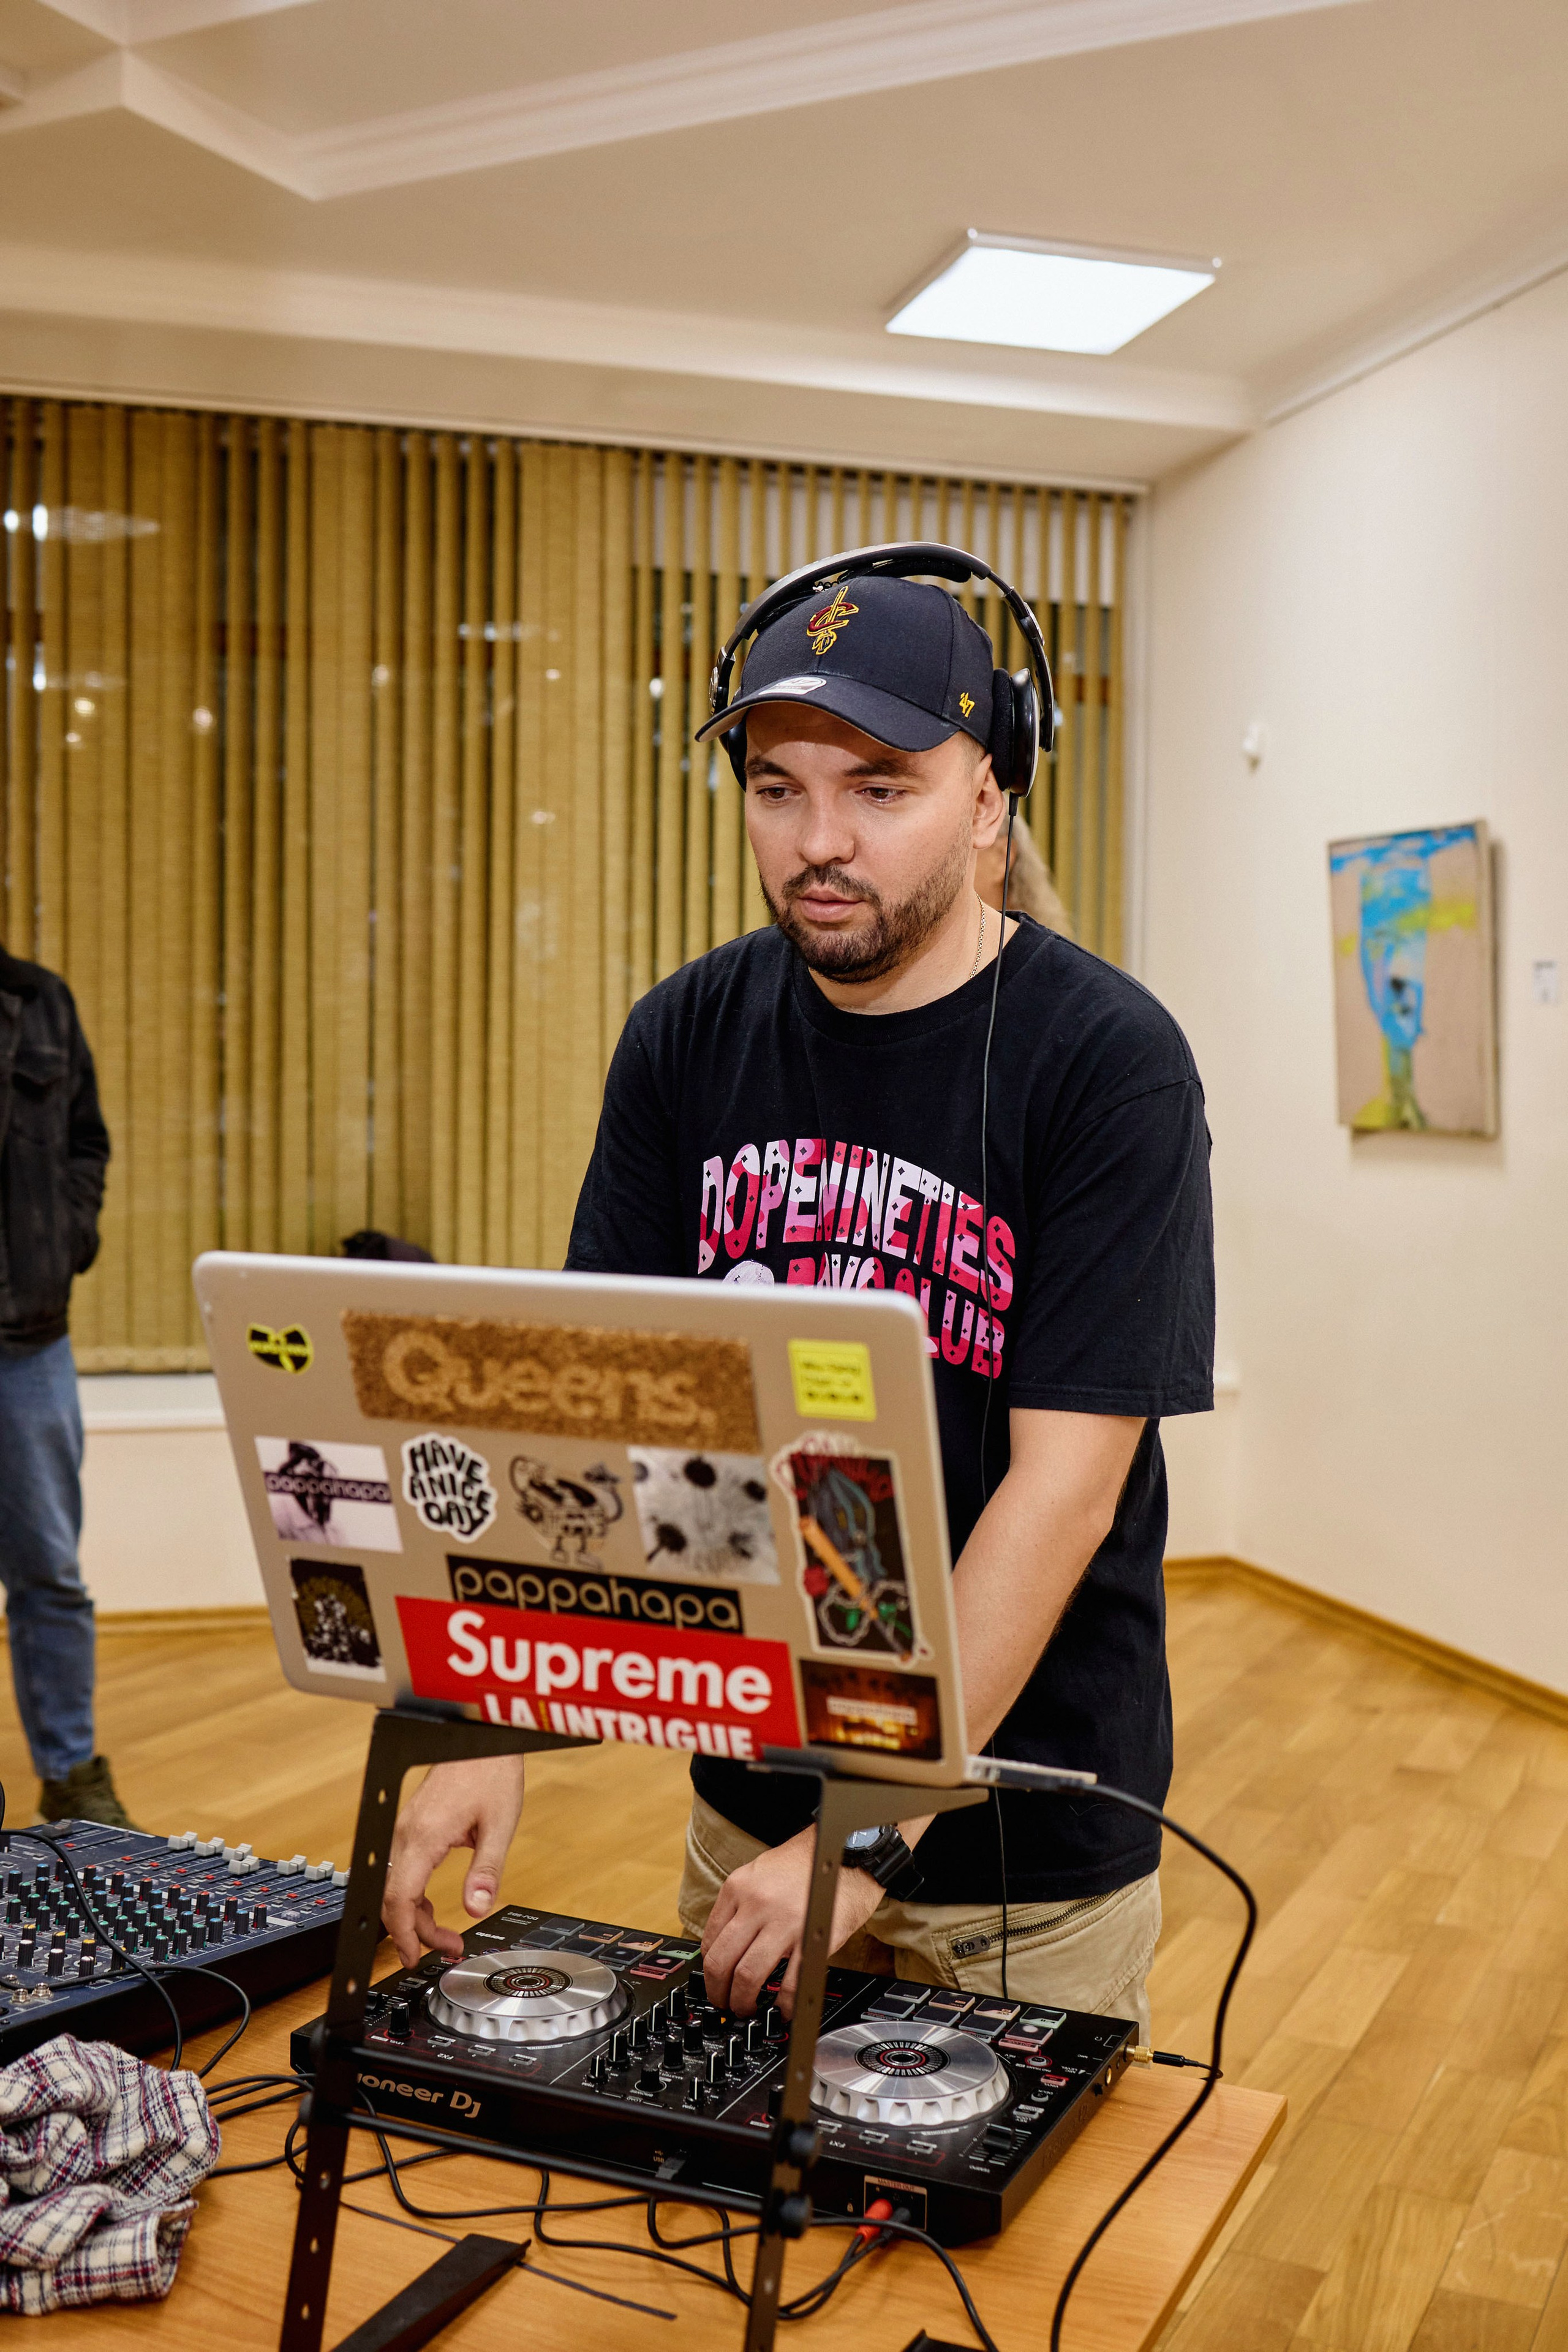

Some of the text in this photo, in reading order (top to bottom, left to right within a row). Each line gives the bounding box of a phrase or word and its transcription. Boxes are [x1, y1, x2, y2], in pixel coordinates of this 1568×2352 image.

[410, 1439, 482, 1483] HAVE
[410, 1472, 491, 1515] A NICE
[424, 1501, 484, 1536] DAY
[454, 1566, 737, 1629] pappahapa
[447, 1610, 772, 1715] Supreme
[484, 1692, 756, 1760] LA INTRIGUE
[356, 2073, 444, 2103] ioneer
